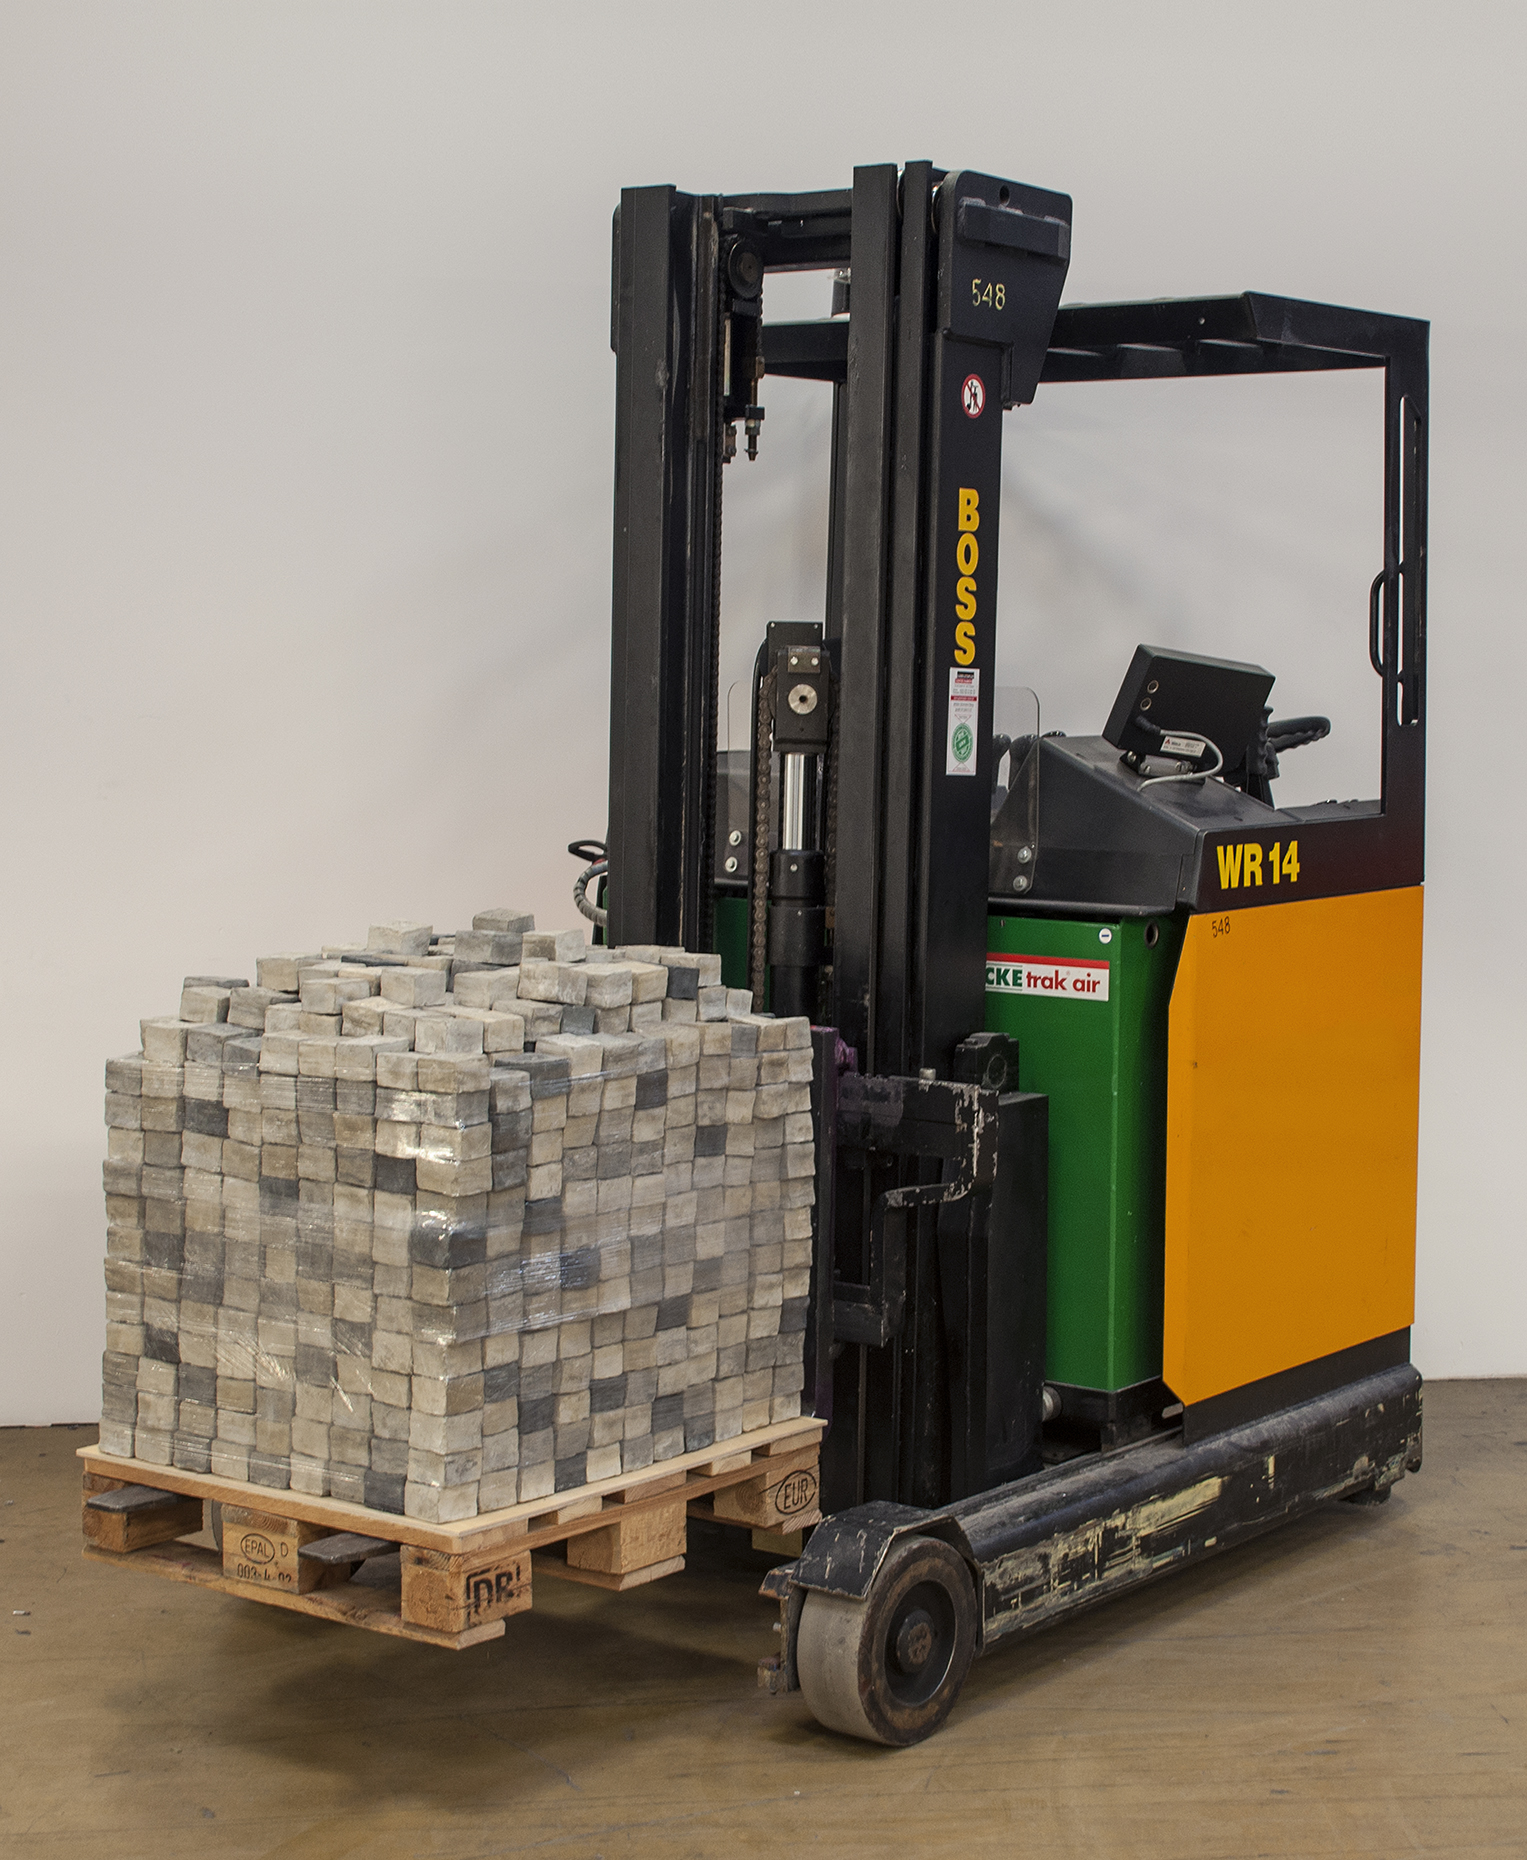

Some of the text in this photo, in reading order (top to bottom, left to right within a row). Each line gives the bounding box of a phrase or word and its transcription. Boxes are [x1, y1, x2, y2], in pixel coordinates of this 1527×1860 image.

[971, 278, 1006, 311] 548
[954, 487, 980, 666] BOSS
[1216, 840, 1300, 890] WR 14
[1211, 916, 1231, 939] 548
[1072, 972, 1101, 993] air
[784, 1478, 808, 1510] EUR
[244, 1538, 270, 1559] EPAL
